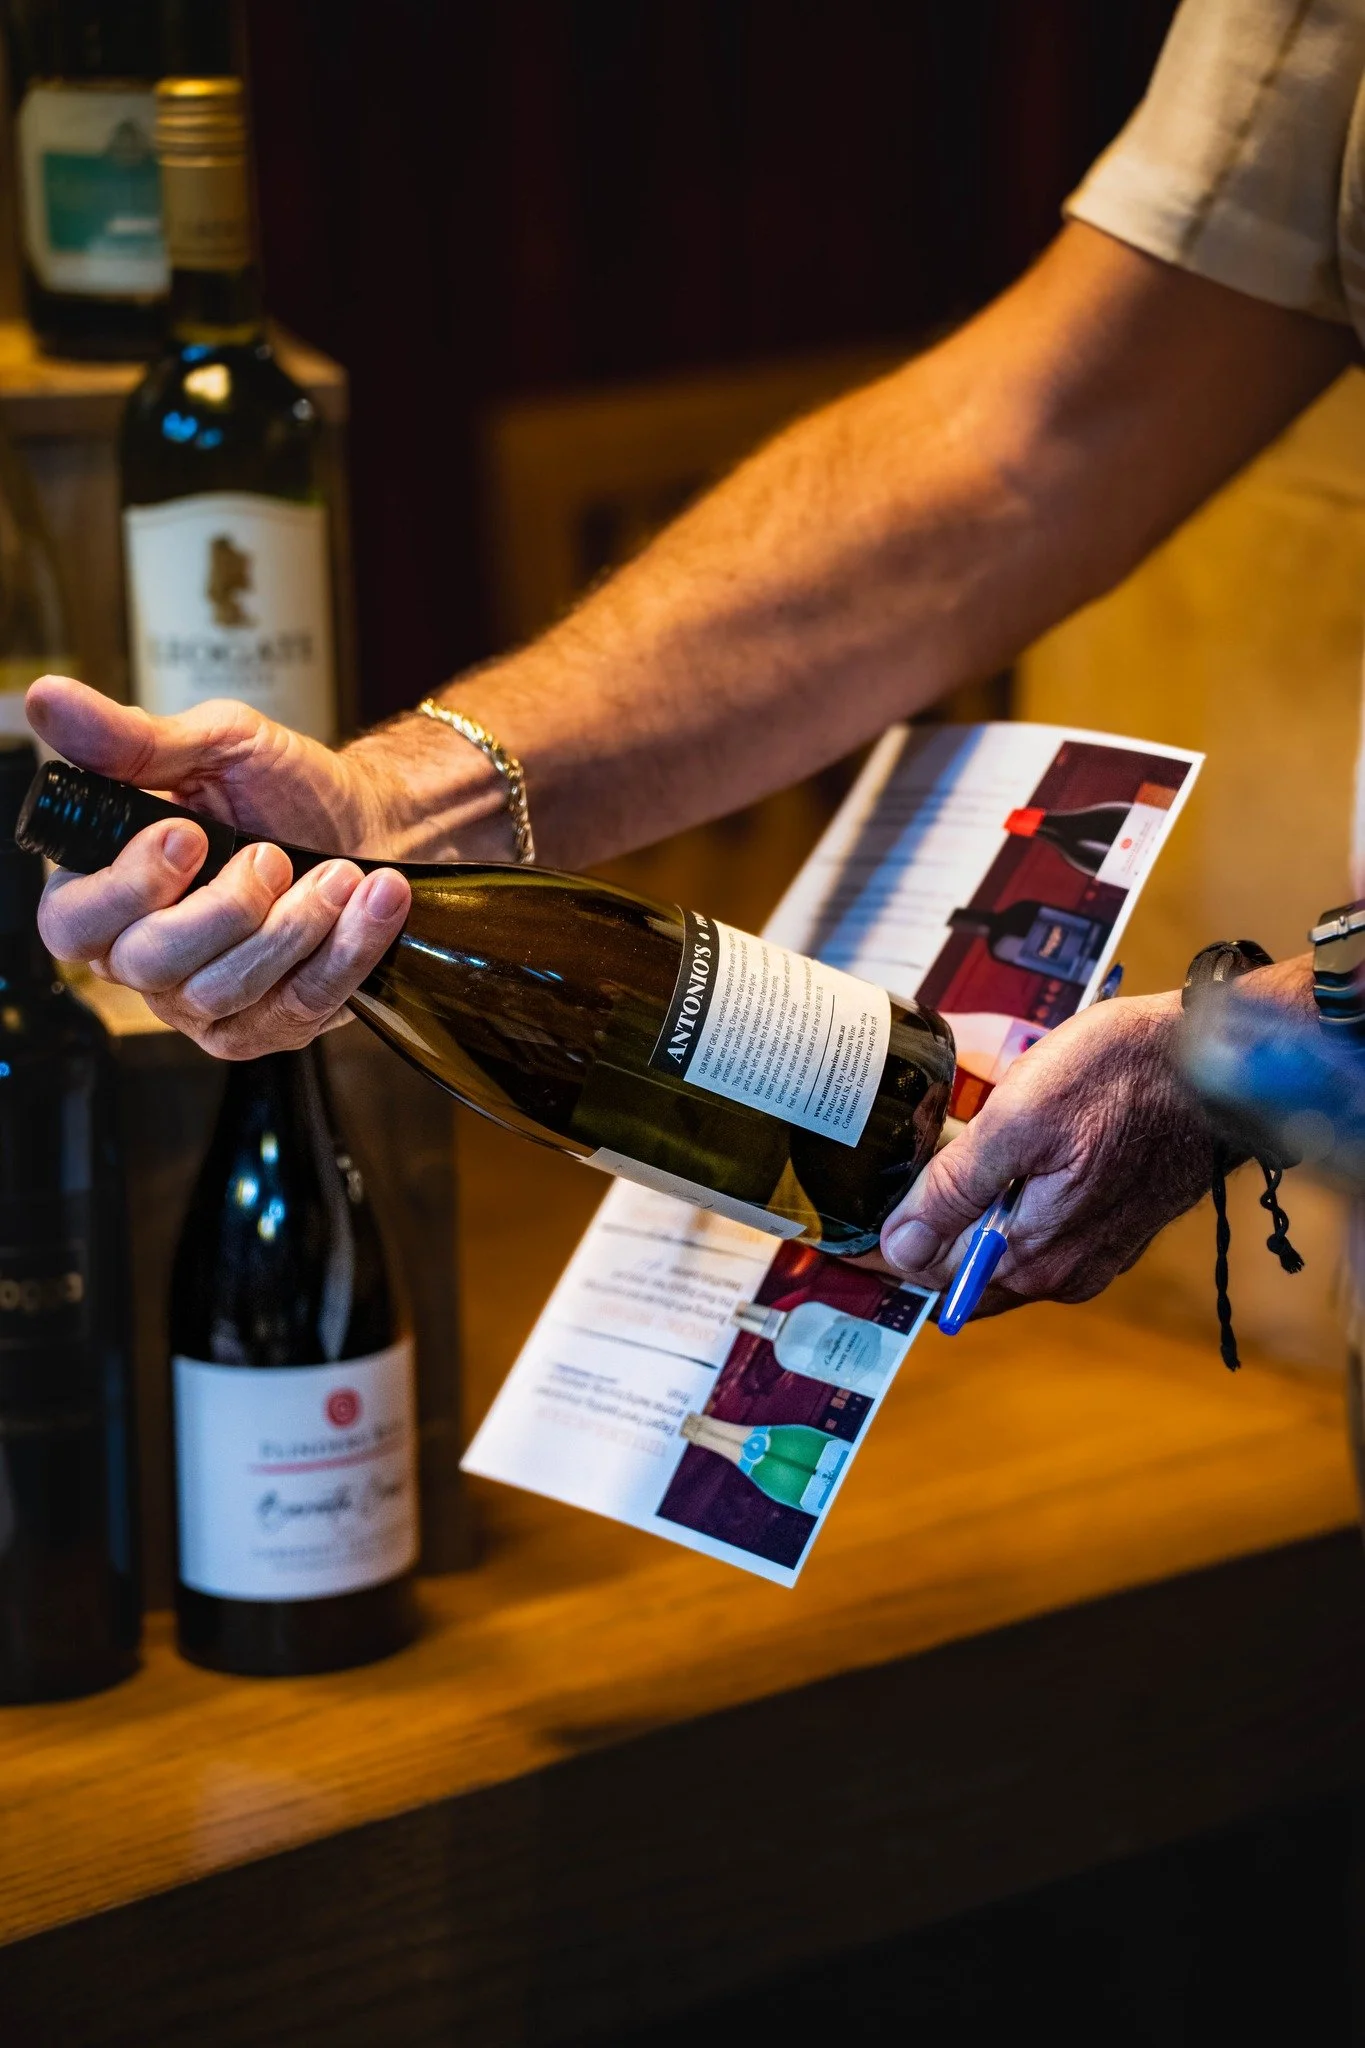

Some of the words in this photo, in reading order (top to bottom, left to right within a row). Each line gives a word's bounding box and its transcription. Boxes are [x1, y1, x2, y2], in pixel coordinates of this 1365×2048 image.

[667, 944, 712, 1063] ANTONIO'S
[733, 992, 742, 1005] Pinot
[729, 1006, 740, 1024] Orange
[764, 1008, 773, 1026] months
[775, 1010, 785, 1029] delicate
[698, 1061, 708, 1074] OUR
[703, 1045, 713, 1062] PINOT
[709, 1032, 718, 1045] GRIS
[718, 996, 728, 1022] wonderful
[724, 977, 733, 997] example
[759, 1030, 767, 1038] for
[774, 1028, 780, 1036] of
[783, 1025, 793, 1040] length
[723, 1026, 735, 1047] exciting,
[756, 1039, 765, 1050] lees
[719, 1046, 727, 1058] and
[721, 1056, 736, 1082] aromatics,
[734, 1023, 745, 1049] particular
[731, 1076, 741, 1086] This
[737, 1059, 747, 1075] single
[750, 1006, 763, 1034] handpicked
[755, 1050, 761, 1058] on
[768, 1036, 780, 1056] displays
[779, 1041, 790, 1056] lovely
[806, 1041, 814, 1056] social
[750, 1058, 759, 1068] left
[763, 1057, 773, 1074] palate
[804, 1056, 810, 1064] on
[840, 1042, 853, 1073] Antonios
[847, 1040, 863, 1082] Canowindra
[709, 1058, 723, 1079] Elegant
[771, 1061, 782, 1083] produce
[774, 1079, 790, 1103] Generous
[788, 1055, 798, 1072] nature
[793, 1043, 801, 1055] and
[798, 1064, 808, 1079] share
[814, 1025, 845, 1117] www.antonioswines.com.au
[742, 1079, 751, 1091] and
[753, 1074, 766, 1095] Moreish
[836, 1073, 845, 1083] by
[764, 1083, 774, 1099] cream
[791, 1086, 800, 1096] free
[841, 1090, 861, 1129] Consumer
[856, 1052, 871, 1087] Enquiries
[786, 1096, 796, 1108] Feel
[822, 1084, 841, 1121] Produced
[835, 1094, 848, 1114] Rodd
[832, 1115, 840, 1125] 90
